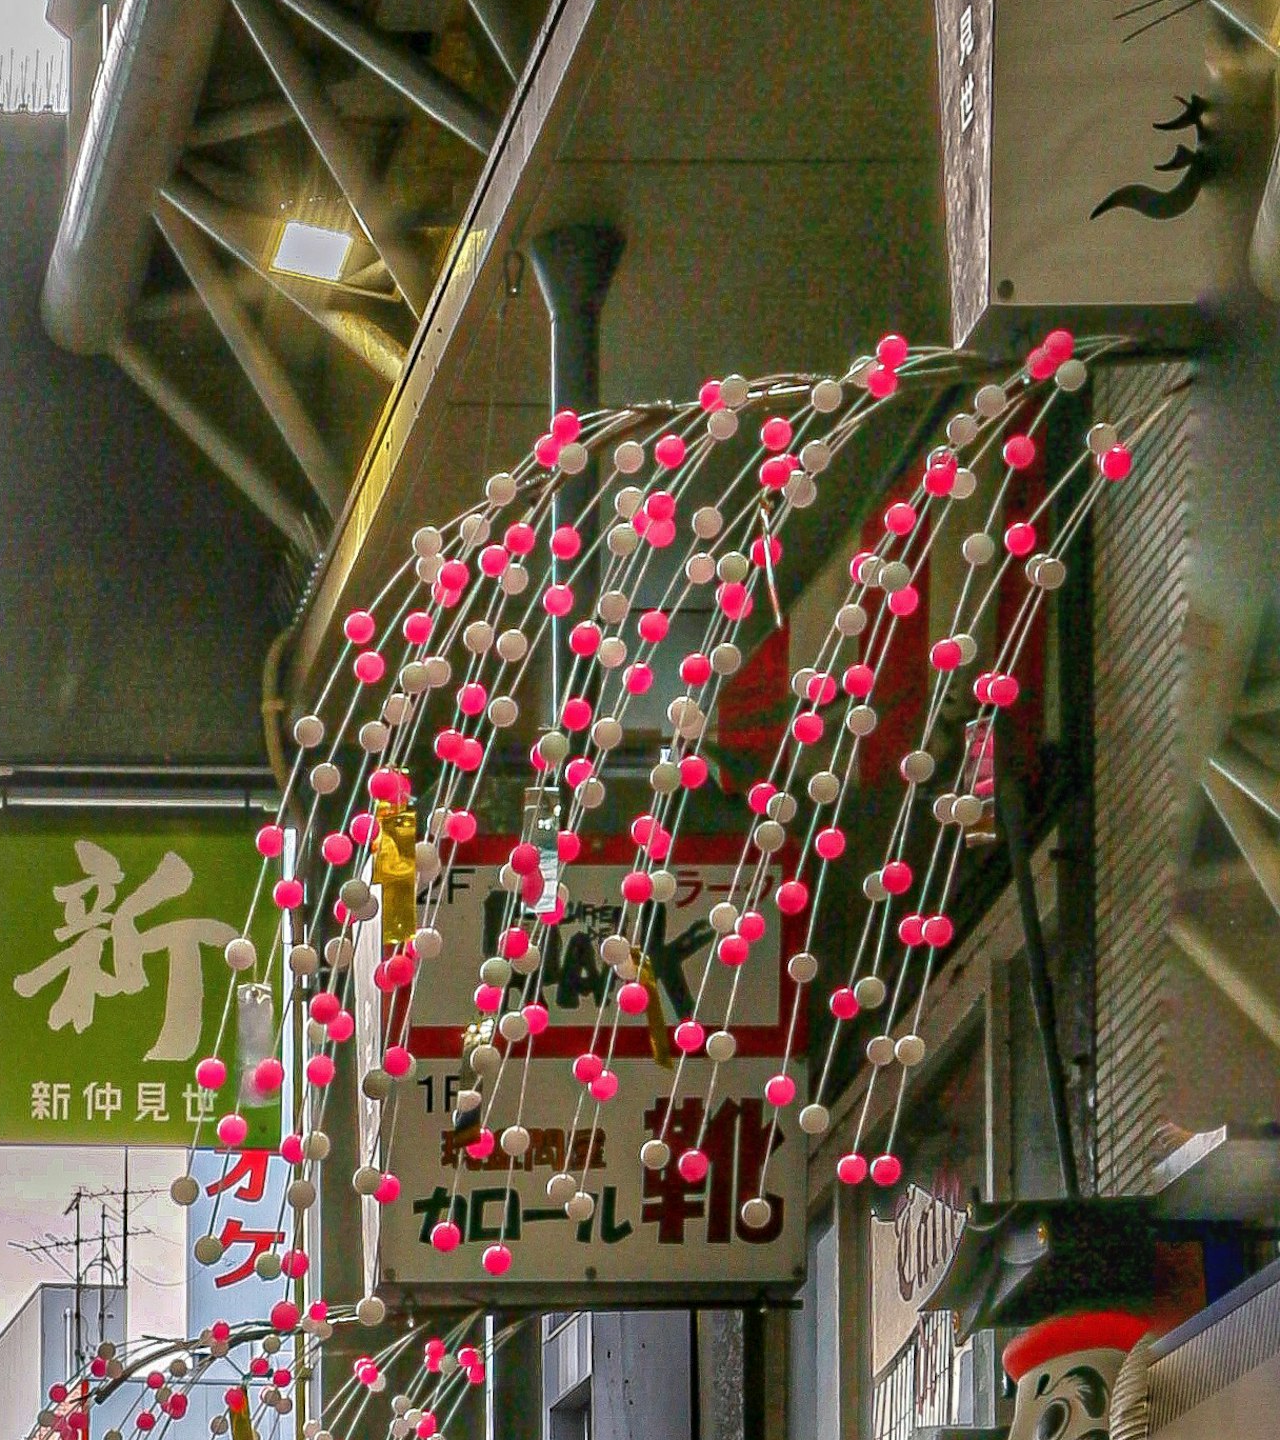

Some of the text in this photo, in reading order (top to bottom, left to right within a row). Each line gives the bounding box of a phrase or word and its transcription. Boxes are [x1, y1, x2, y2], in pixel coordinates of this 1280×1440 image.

[12, 839, 238, 1063] 新
[29, 1081, 218, 1124] 新仲見世
[413, 1186, 634, 1245] カロール
[640, 1097, 785, 1244] 靴
